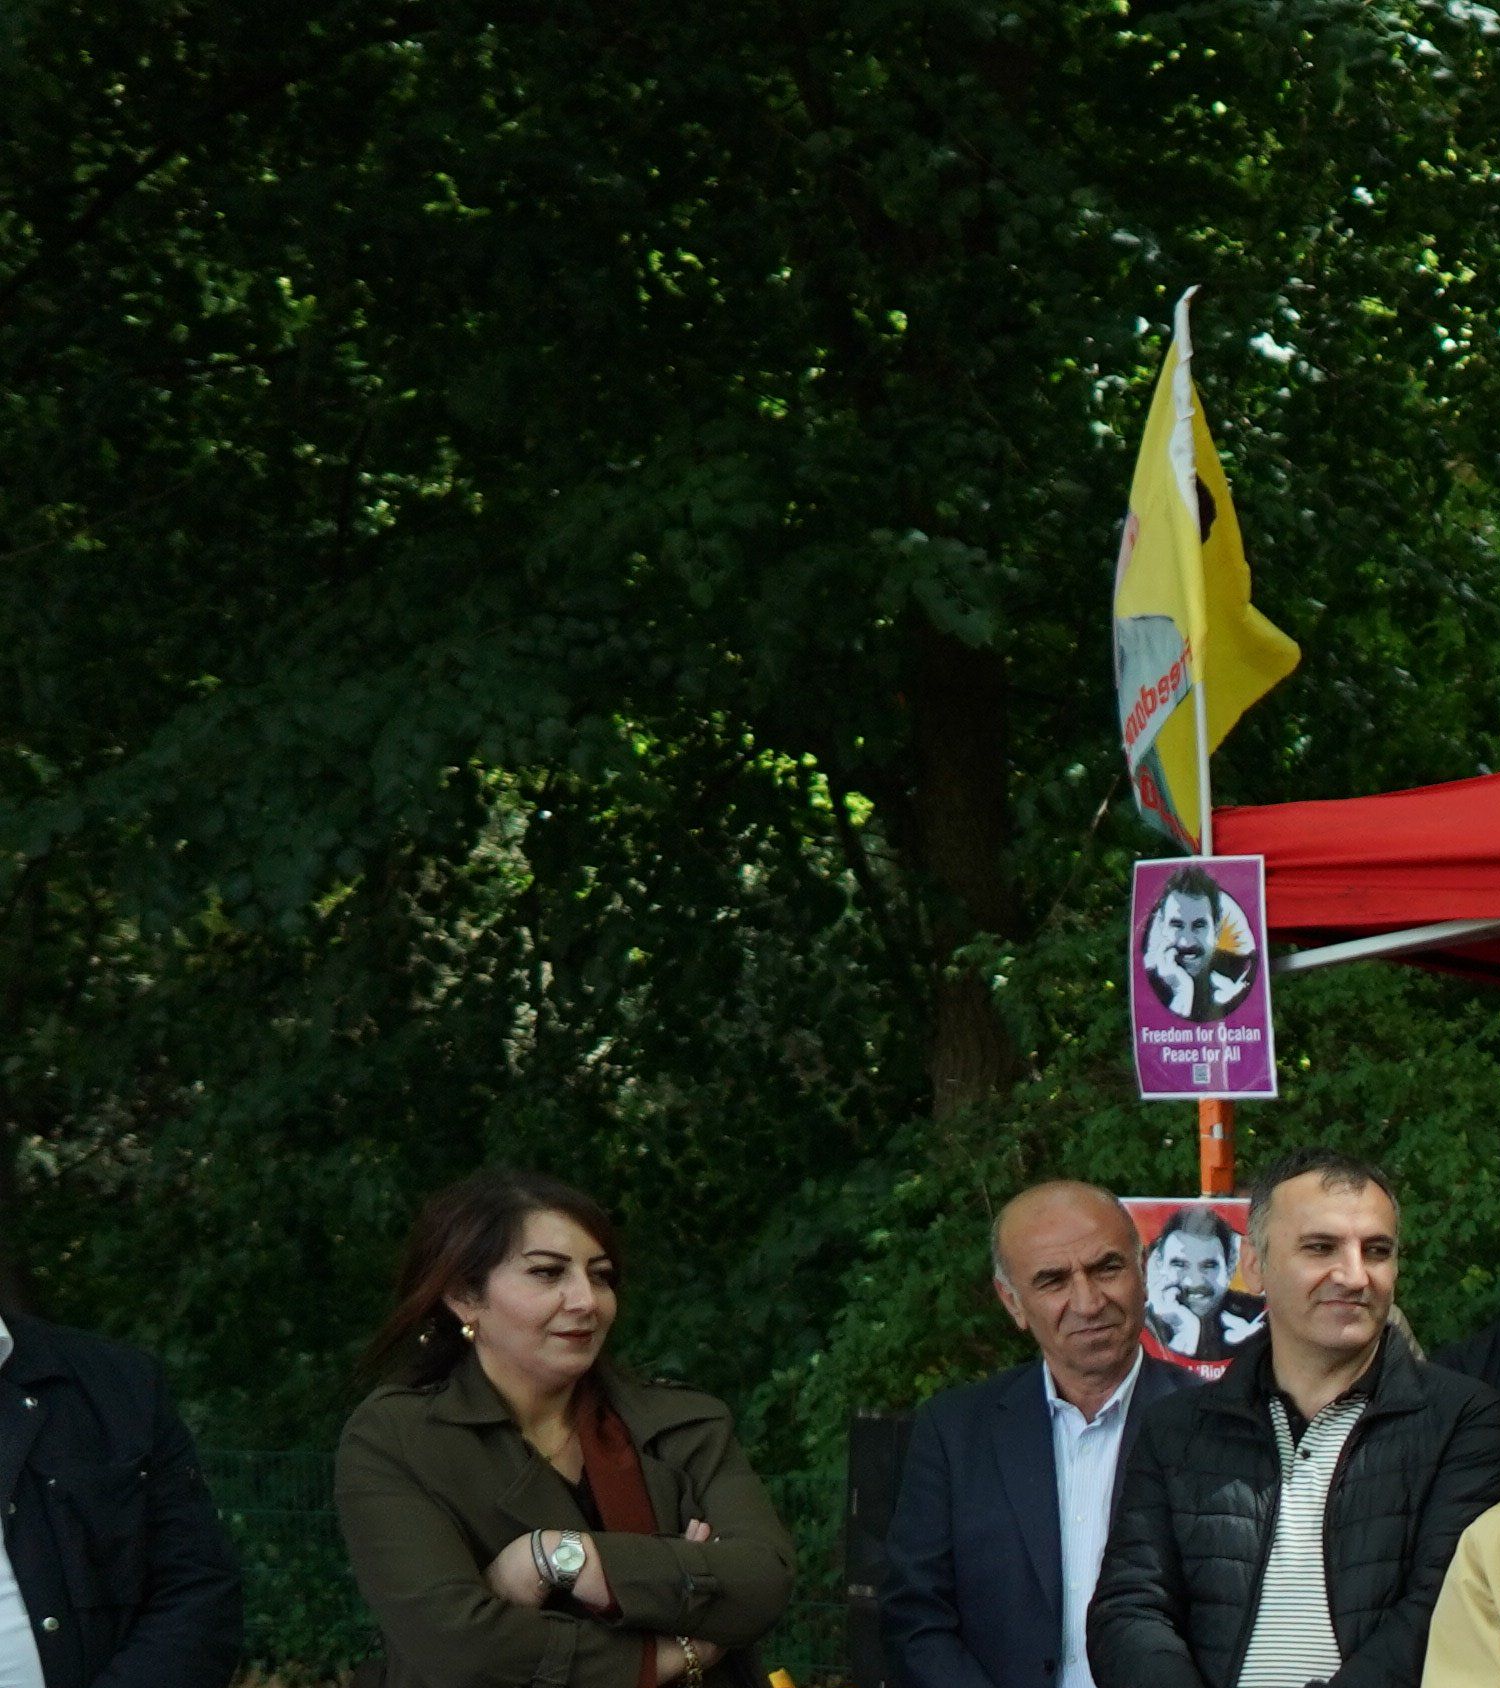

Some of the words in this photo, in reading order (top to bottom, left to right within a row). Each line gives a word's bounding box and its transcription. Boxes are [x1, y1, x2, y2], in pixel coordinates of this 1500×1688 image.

[1141, 1026, 1193, 1043] Freedom
[1196, 1025, 1215, 1042] for
[1217, 1021, 1262, 1042] Öcalan
[1162, 1046, 1199, 1063] Peace
[1202, 1046, 1220, 1063] for
[1222, 1045, 1241, 1063] All
